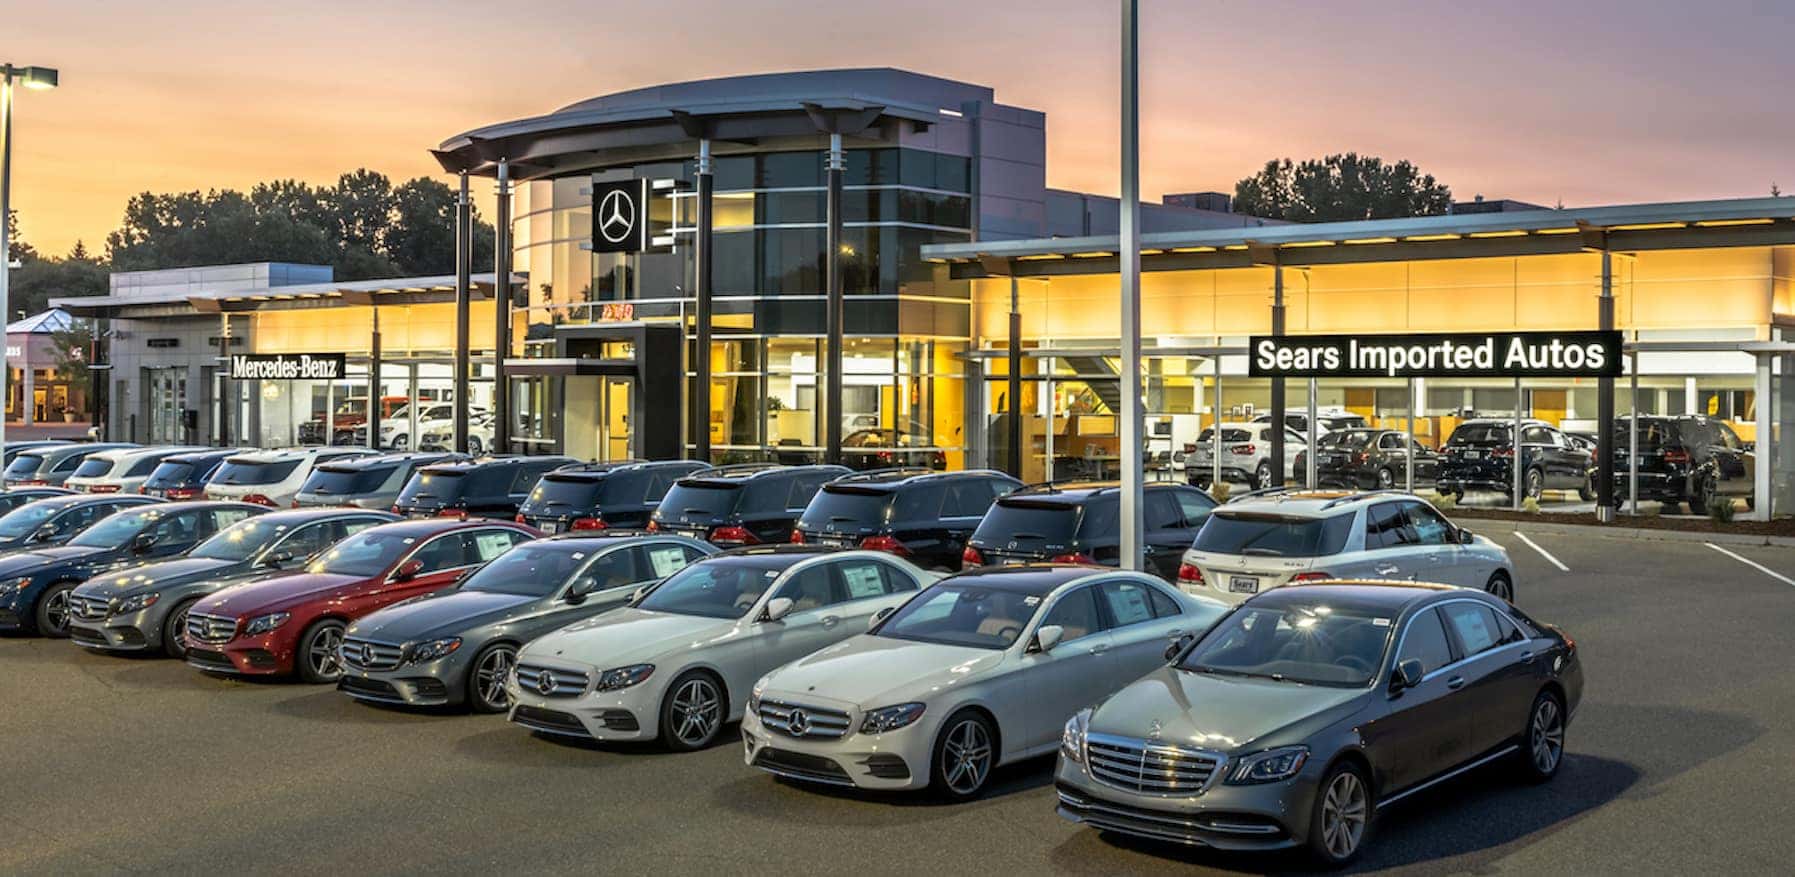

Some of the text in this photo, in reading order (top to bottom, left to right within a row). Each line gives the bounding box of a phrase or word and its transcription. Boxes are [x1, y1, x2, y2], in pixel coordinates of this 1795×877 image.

[232, 355, 337, 378] Mercedes-Benz
[1256, 337, 1605, 376] Sears Imported Autos
